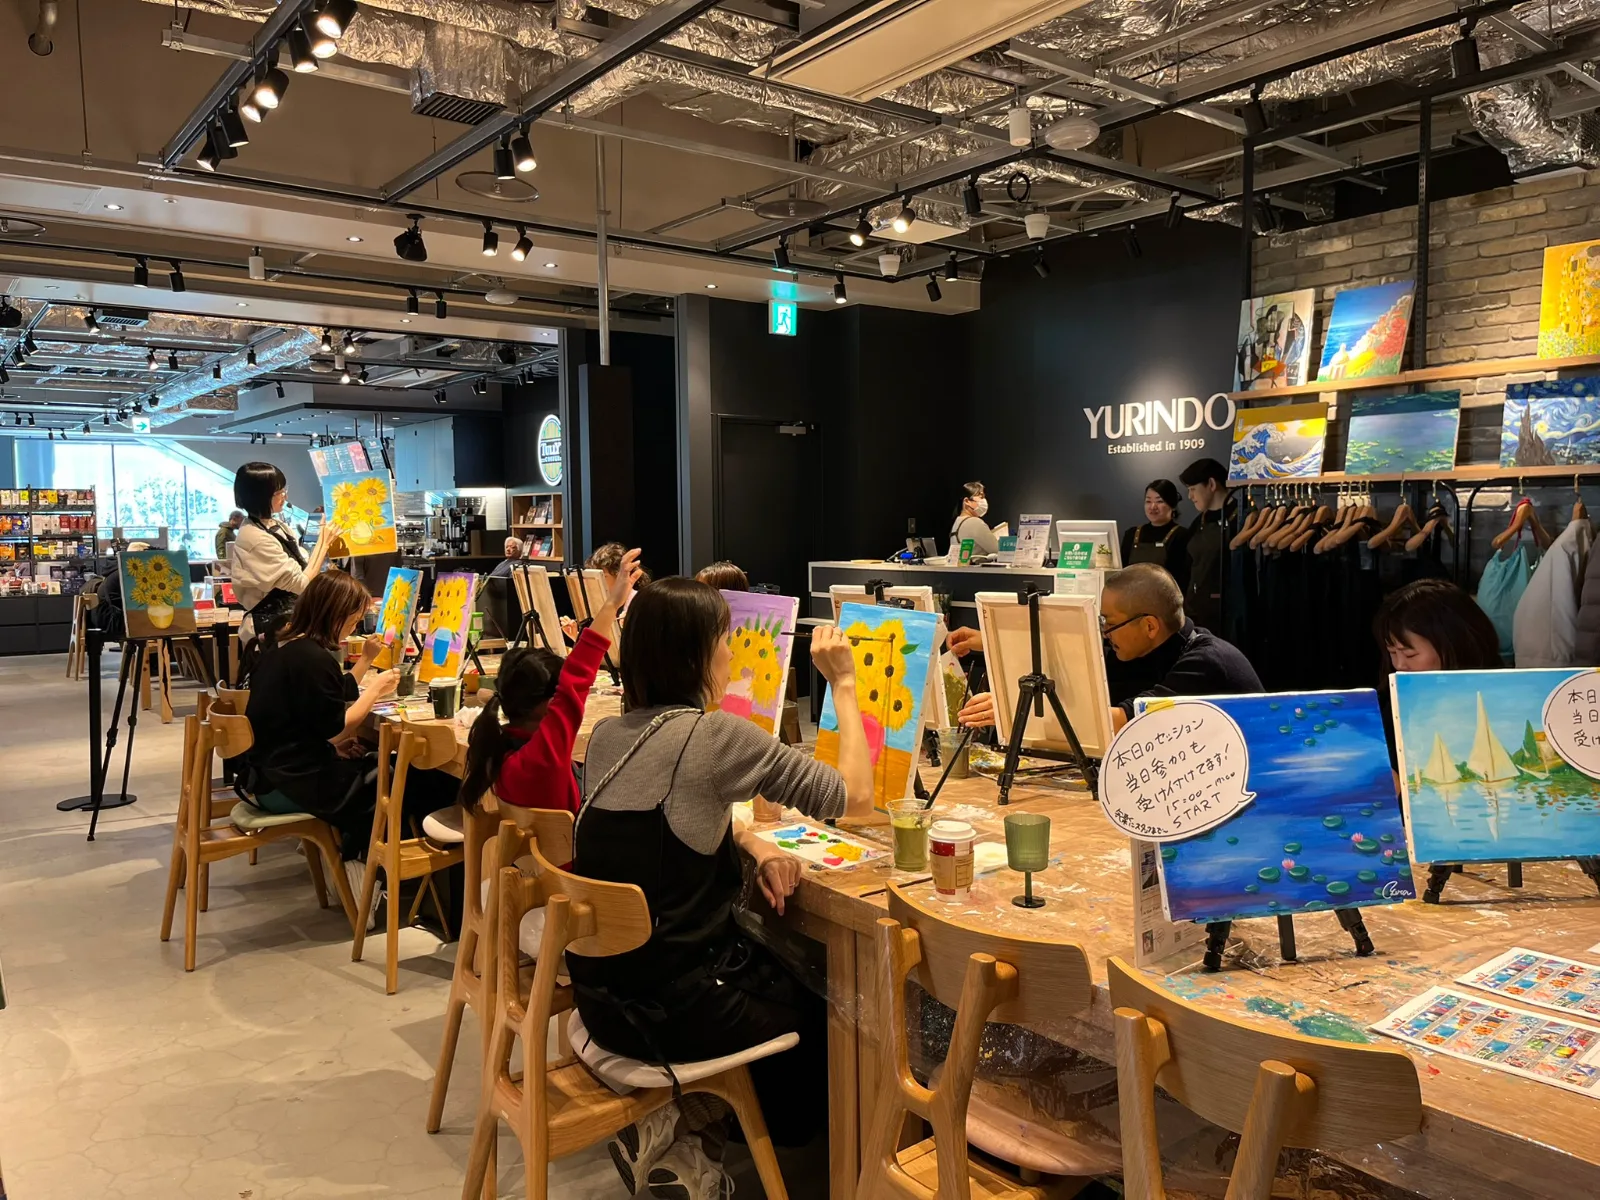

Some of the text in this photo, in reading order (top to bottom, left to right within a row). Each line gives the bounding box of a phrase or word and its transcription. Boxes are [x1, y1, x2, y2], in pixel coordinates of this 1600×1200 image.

[1083, 392, 1236, 440] YURINDO
[541, 441, 562, 457] TULLY
[1108, 438, 1205, 455] Established in 1909
[1112, 718, 1204, 769] 本日のセッション
[1126, 741, 1206, 793] 当日参加も
[1173, 792, 1220, 828] START
